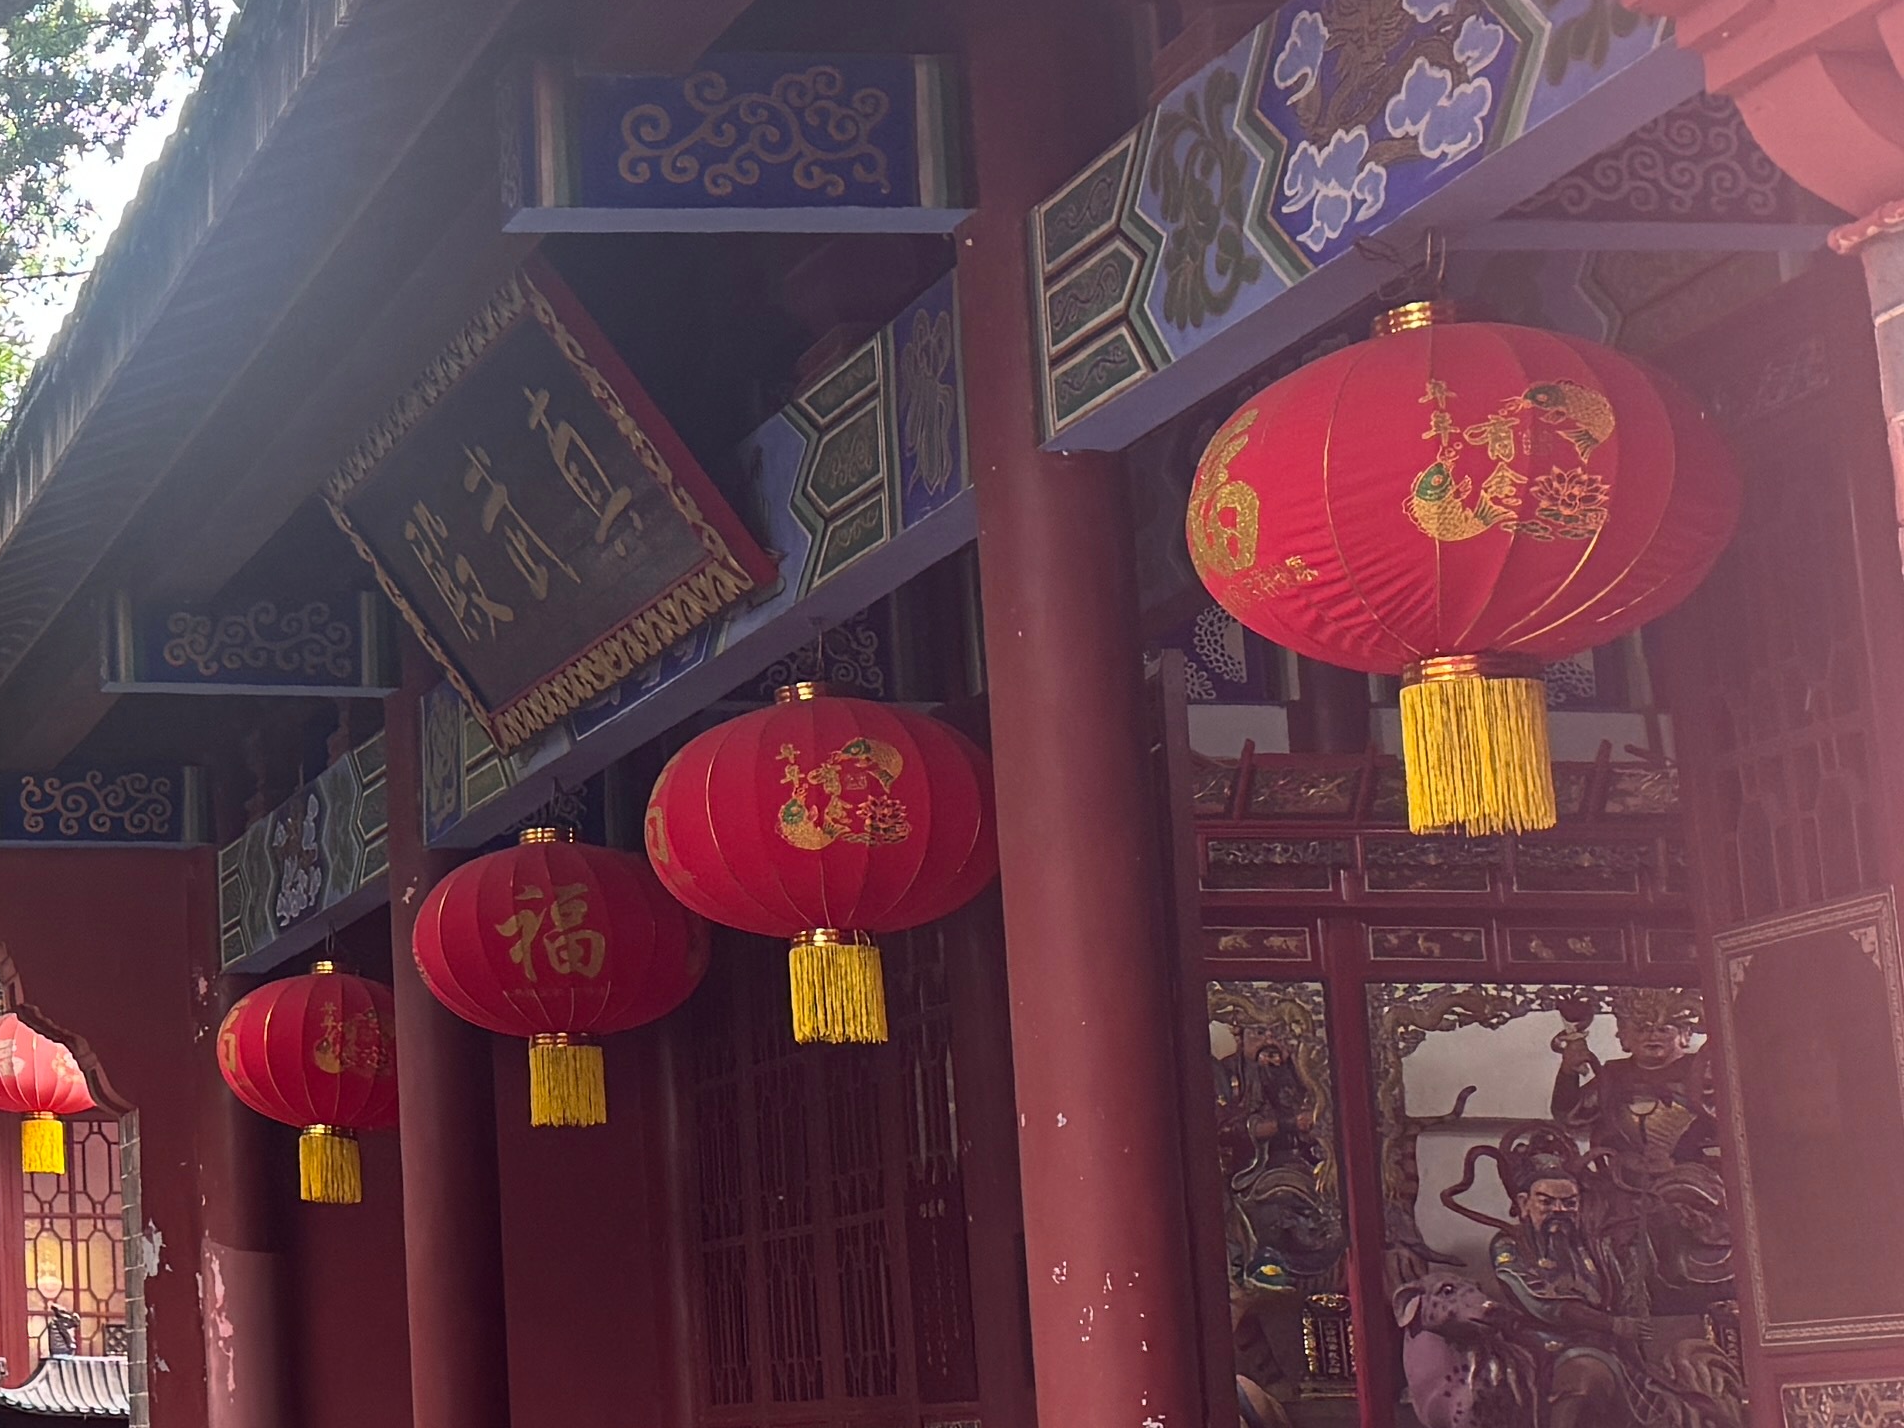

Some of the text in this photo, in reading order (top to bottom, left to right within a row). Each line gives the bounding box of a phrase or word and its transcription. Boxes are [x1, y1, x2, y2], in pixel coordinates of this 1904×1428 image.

[405, 386, 642, 643] 真武殿
[495, 882, 606, 983] 福
